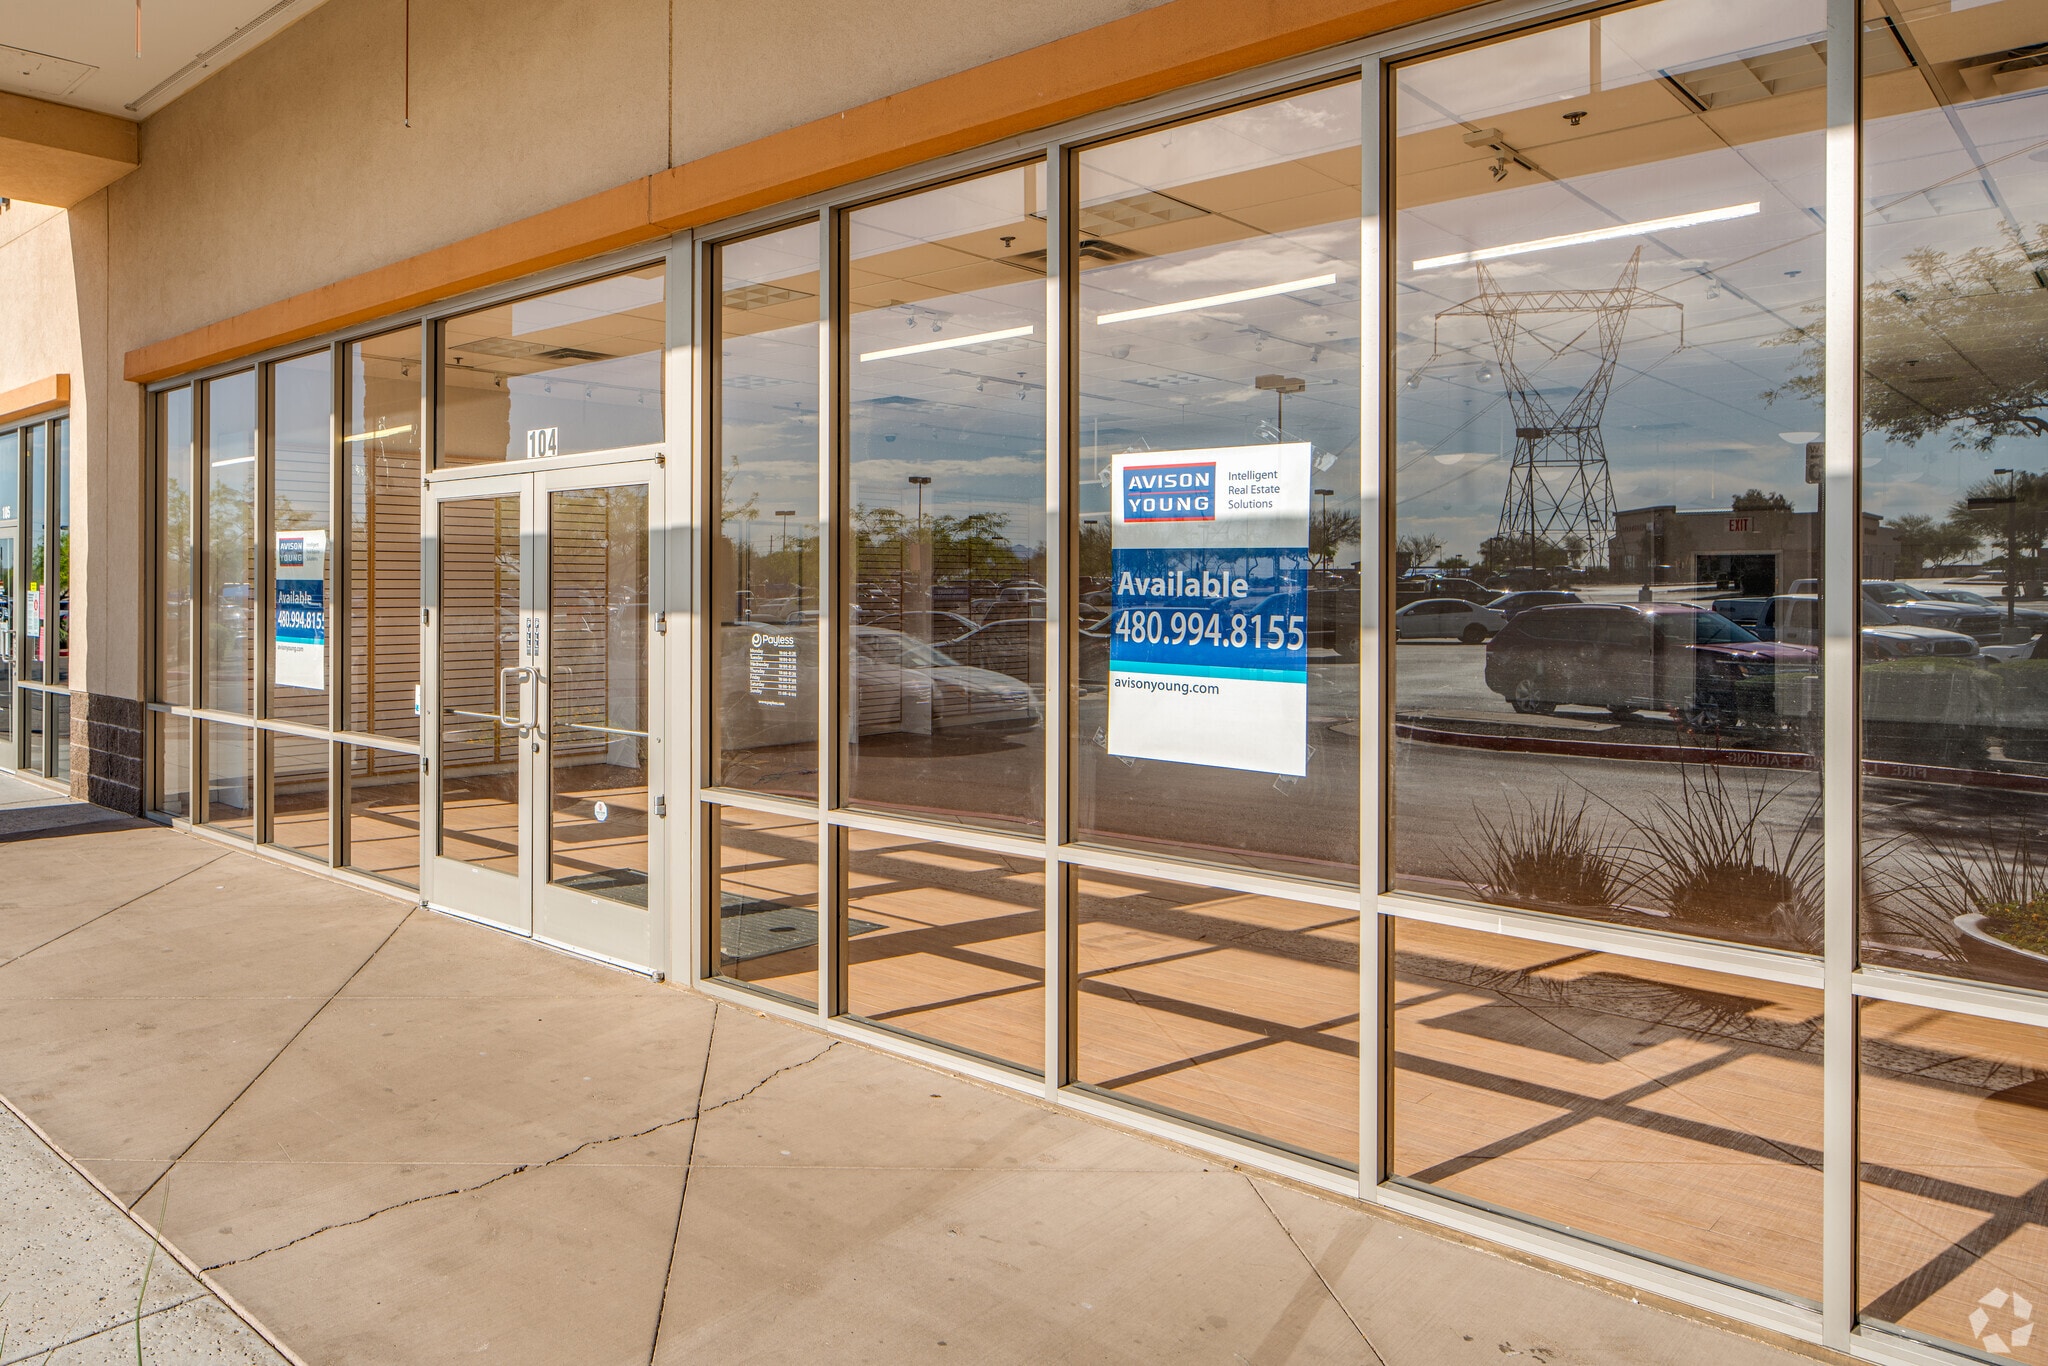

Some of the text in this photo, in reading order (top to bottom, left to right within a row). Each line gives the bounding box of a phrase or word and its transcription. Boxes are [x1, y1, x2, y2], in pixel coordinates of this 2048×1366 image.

[529, 428, 557, 457] 104
[1128, 472, 1210, 490] AVISON
[1228, 470, 1278, 482] Intelligent
[1228, 484, 1281, 495] Real Estate
[1128, 496, 1210, 513] YOUNG
[1228, 499, 1273, 510] Solutions
[1729, 518, 1749, 532] EXIT
[280, 542, 303, 550] AVISON
[279, 553, 303, 562] YOUNG
[1117, 570, 1249, 598] Available
[278, 590, 313, 604] Available
[1115, 610, 1305, 651] 480.994.8155
[762, 634, 794, 647] Payless
[1114, 677, 1220, 695] avisonyoung.com
